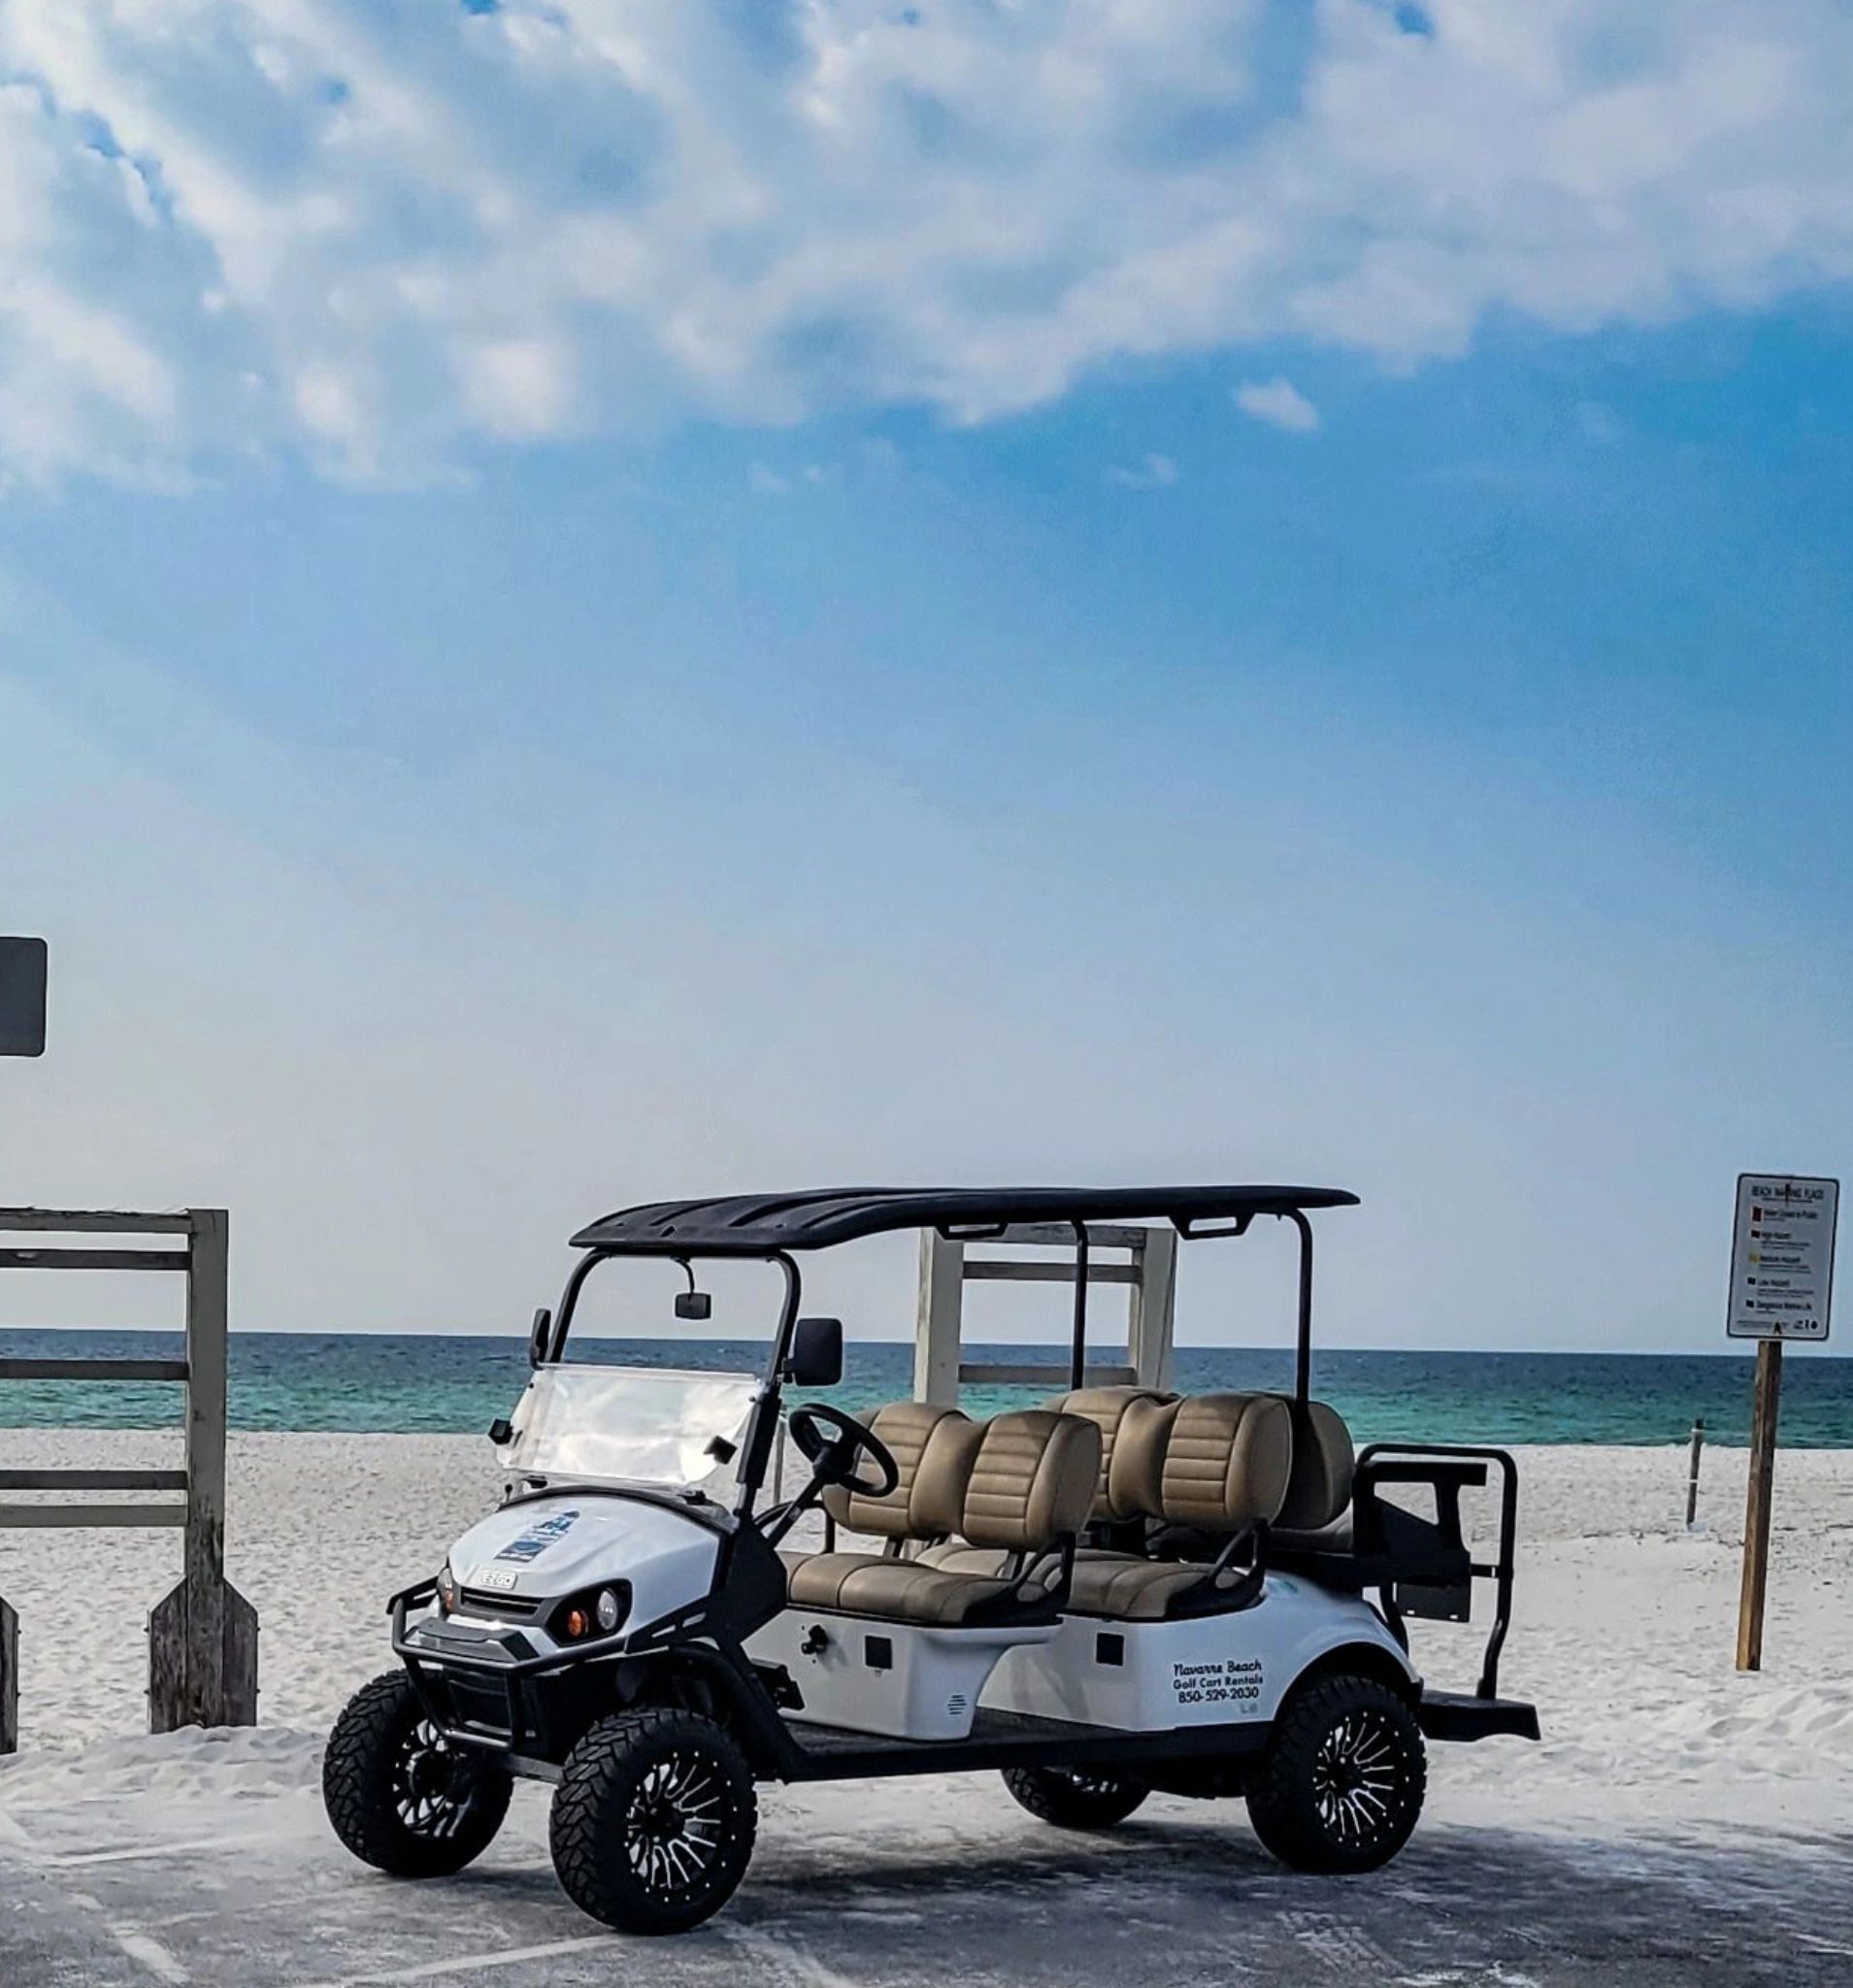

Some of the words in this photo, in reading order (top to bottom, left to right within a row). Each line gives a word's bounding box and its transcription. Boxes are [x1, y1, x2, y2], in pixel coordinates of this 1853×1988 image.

[1173, 1663, 1223, 1676] Navarre
[1227, 1658, 1262, 1673] Beach
[1173, 1678, 1196, 1690] Golf
[1200, 1678, 1221, 1688] Cart
[1225, 1674, 1263, 1686] Rentals
[1178, 1686, 1259, 1703] 850-529-2030
